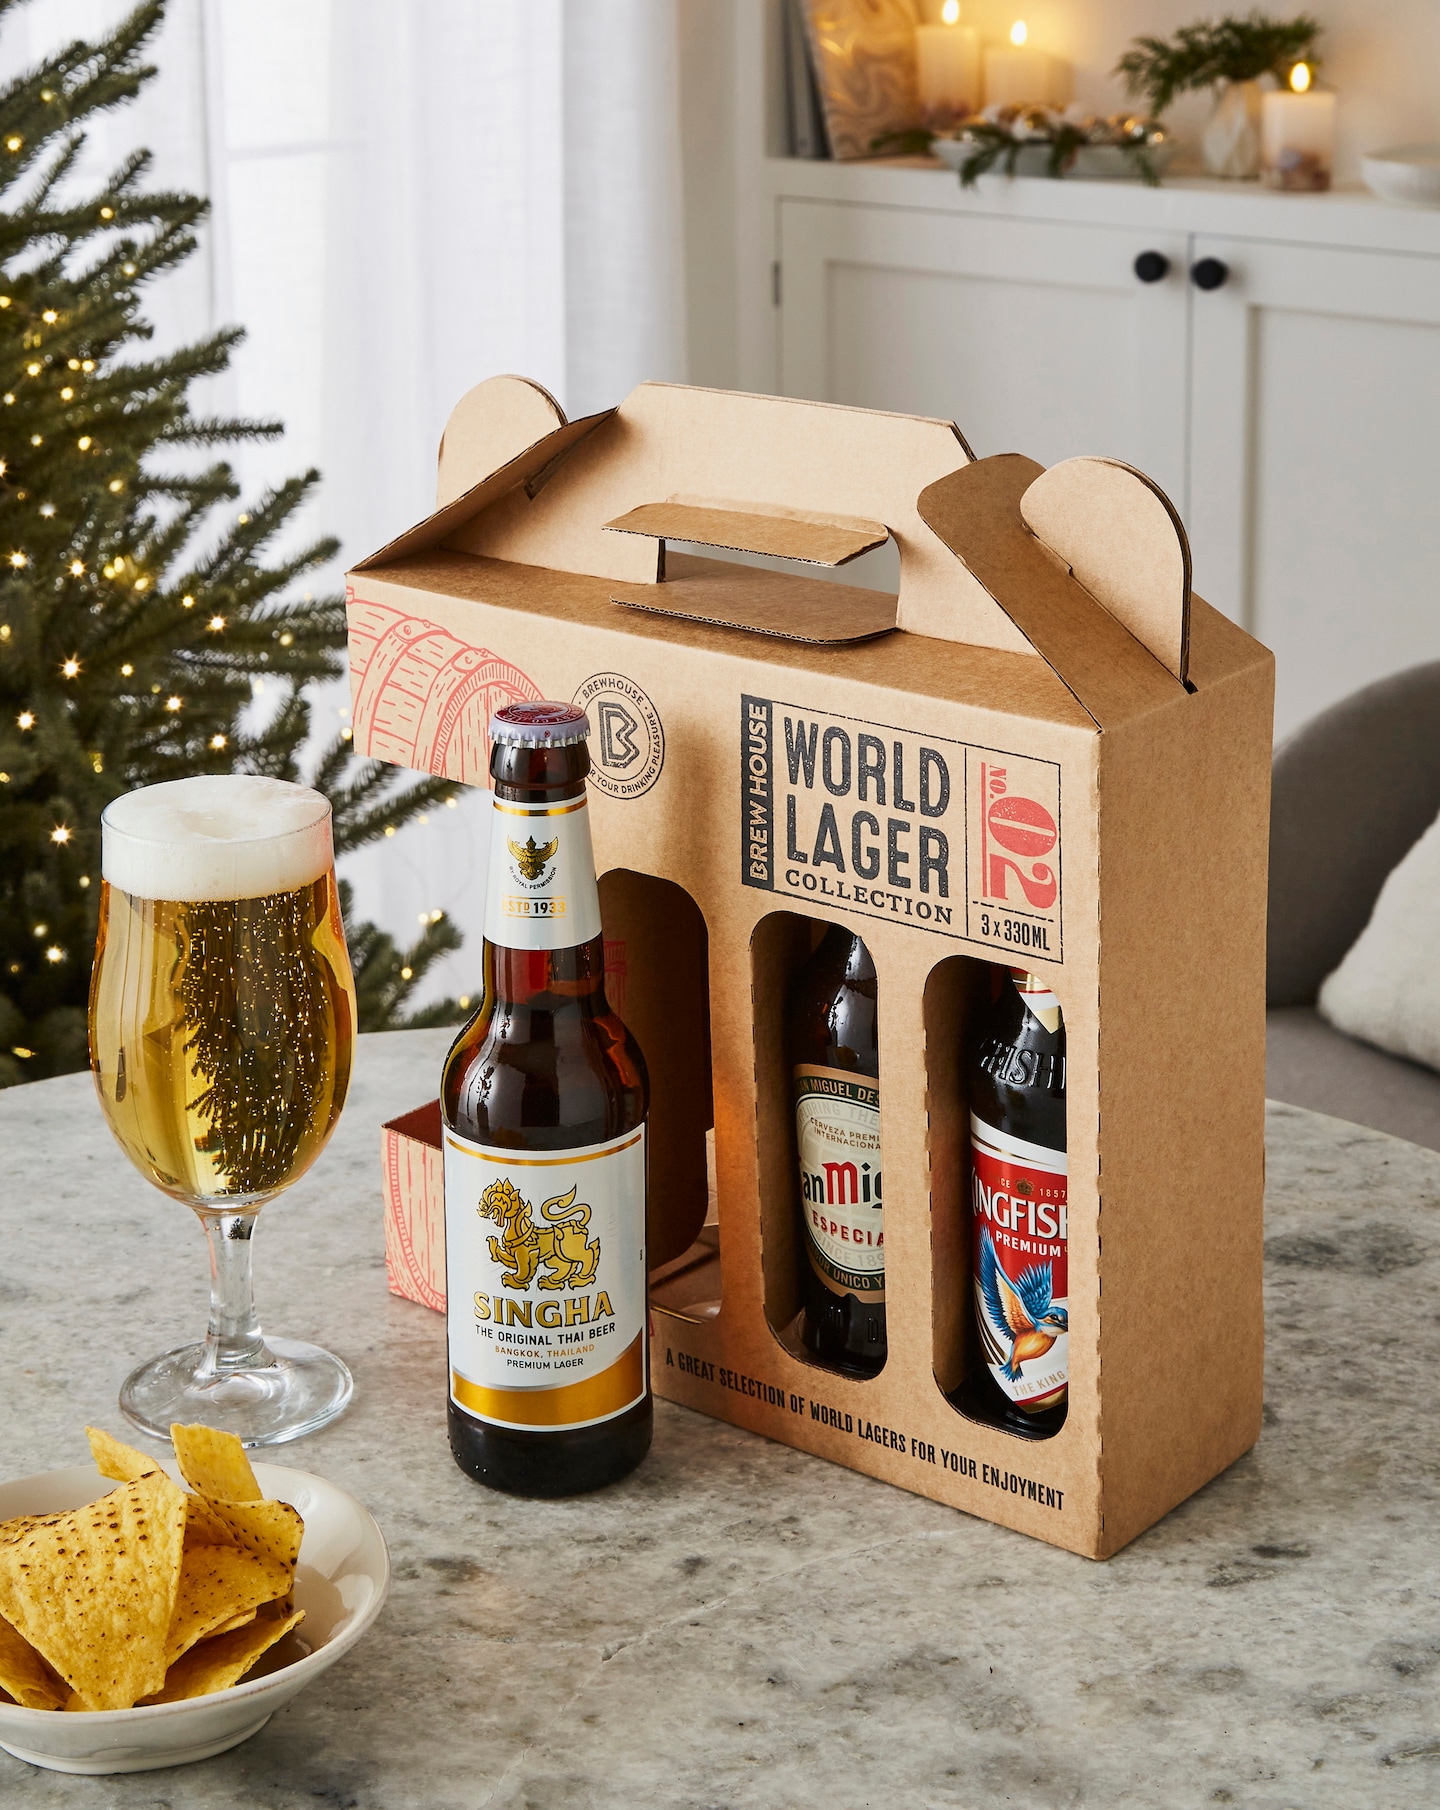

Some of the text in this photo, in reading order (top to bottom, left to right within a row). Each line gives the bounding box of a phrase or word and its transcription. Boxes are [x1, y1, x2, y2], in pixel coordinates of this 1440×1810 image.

[582, 678, 644, 705] BREWHOUSE
[596, 712, 661, 794] YOUR DRINKING PLEASURE
[784, 716, 950, 818] WORLD
[749, 703, 769, 881] BREW HOUSE
[787, 794, 949, 898] LAGER
[988, 796, 1057, 909] 02
[512, 874, 528, 889] ROYAL
[529, 866, 557, 890] PERMISSION
[502, 899, 566, 914] ESTD 1933
[785, 868, 953, 925] COLLECTION
[810, 1078, 852, 1097] MIGUEL
[810, 1117, 845, 1137] CERVEZA
[1040, 1188, 1066, 1198] 1857
[995, 1230, 1061, 1257] PREMIUM
[473, 1291, 615, 1329] SINGHA
[475, 1322, 616, 1346] THE ORIGINAL THAI BEER
[495, 1344, 595, 1359] BANGKOK, THAILAND
[507, 1358, 584, 1369] PREMIUM LAGER
[1012, 1370, 1065, 1396] THE KING
[666, 1348, 1064, 1510] A GREAT SELECTION OF WORLD LAGERS FOR YOUR ENJOYMENT
